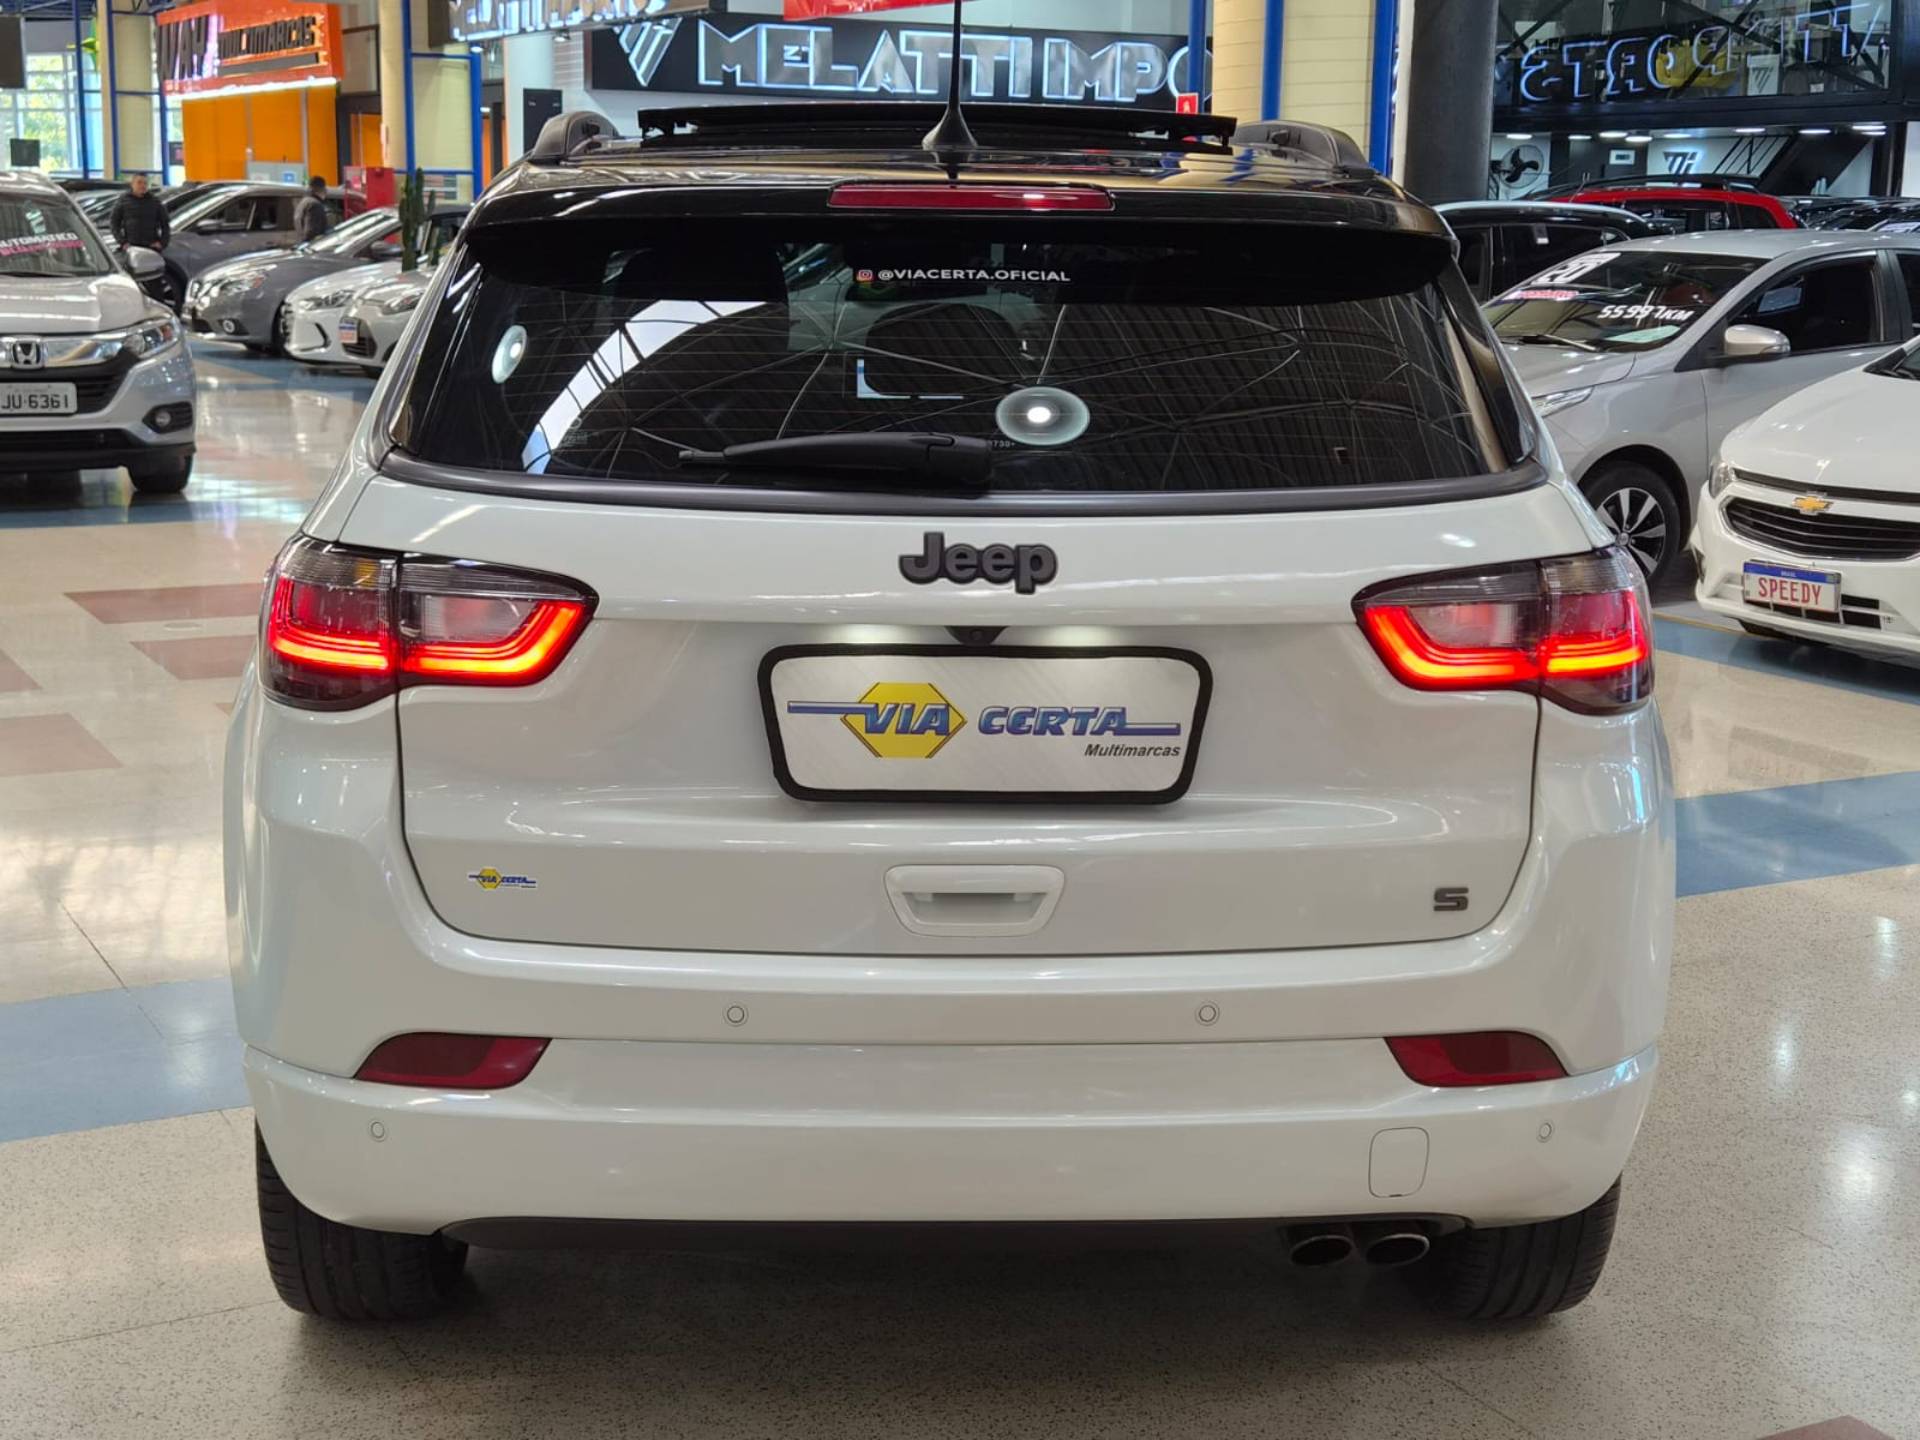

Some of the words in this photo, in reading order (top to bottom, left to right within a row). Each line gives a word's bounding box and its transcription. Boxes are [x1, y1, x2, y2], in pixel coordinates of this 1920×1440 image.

[878, 269, 1071, 281] @VIACERTA.OFICIAL
[899, 532, 1058, 595] Jeep
[1758, 577, 1822, 605] SPEEDY
[863, 703, 951, 736] VIA
[978, 706, 1127, 736] CERTA
[1084, 743, 1181, 757] Multimarcas
[1433, 887, 1469, 911] S
